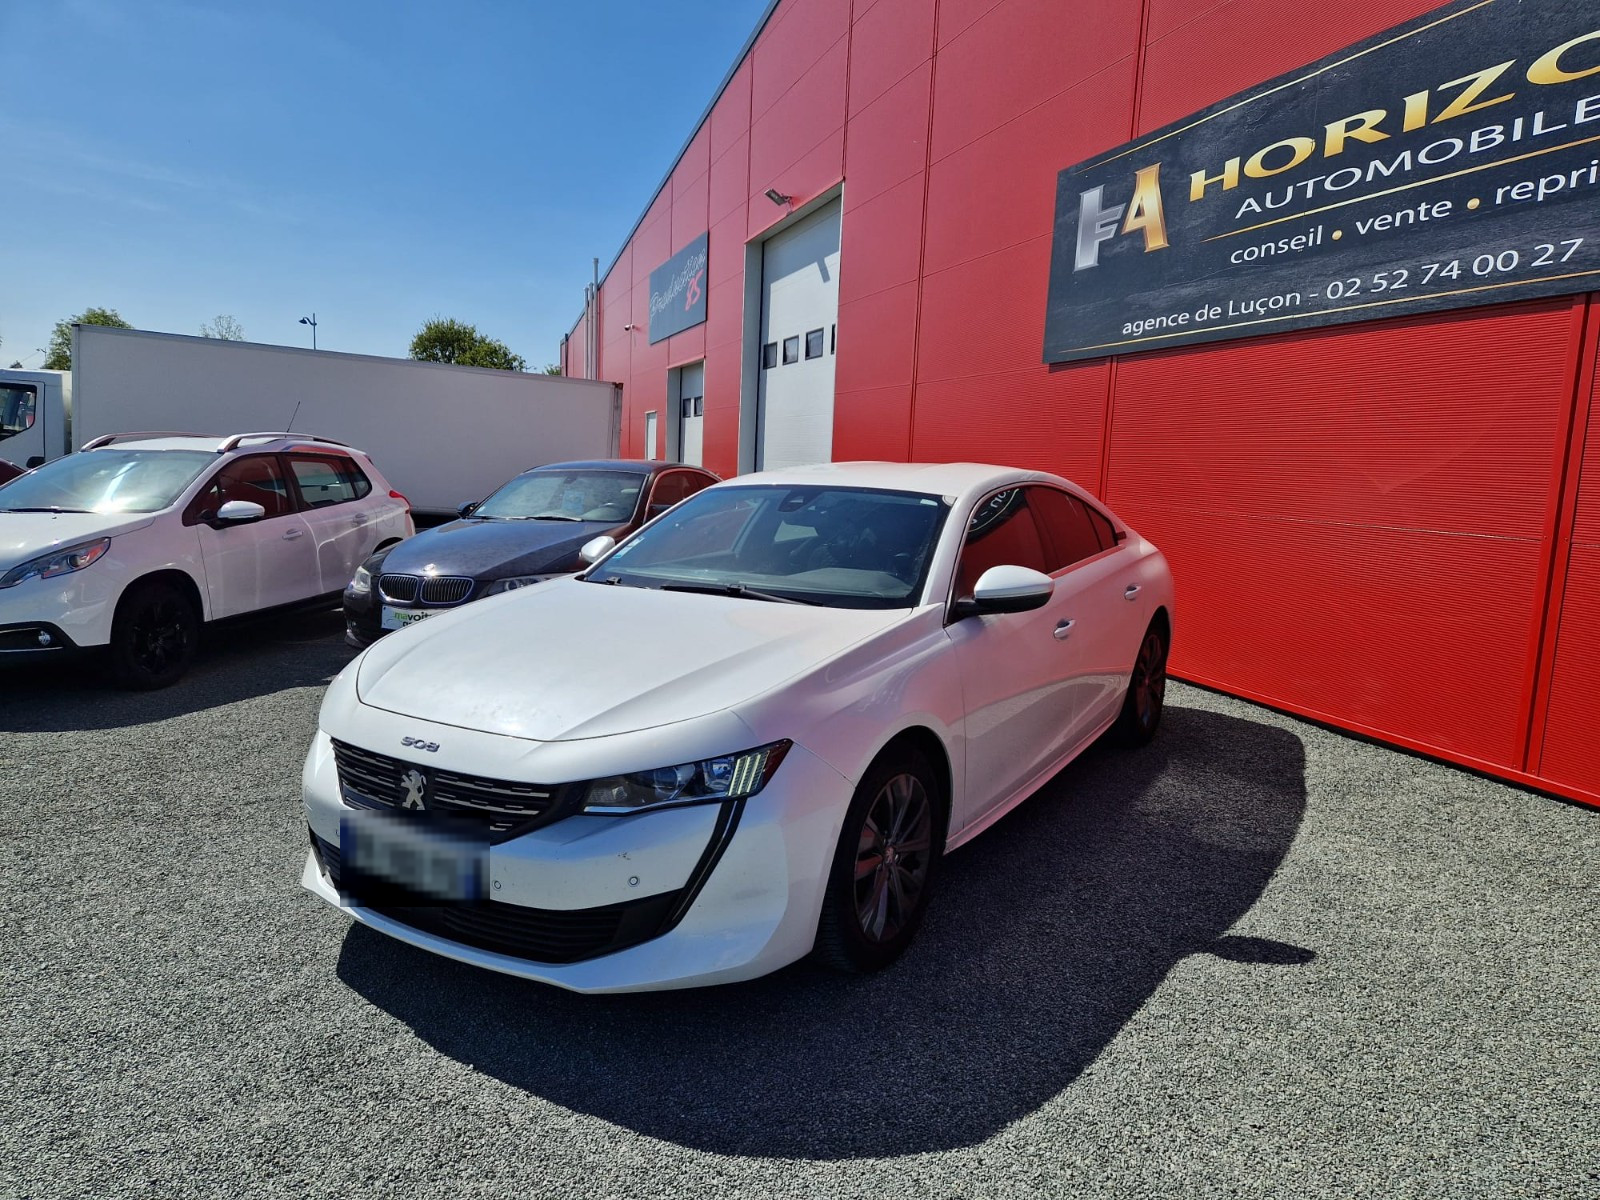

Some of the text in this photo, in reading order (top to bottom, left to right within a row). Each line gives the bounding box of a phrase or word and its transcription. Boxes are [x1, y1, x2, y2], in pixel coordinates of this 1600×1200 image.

[1235, 94, 1600, 218] AUTOMOBILE
[1229, 159, 1599, 264] conseil vente repri
[1122, 312, 1189, 335] agence
[1195, 304, 1222, 321] de
[1228, 291, 1301, 316] Luçon
[1326, 279, 1361, 299] 02
[1372, 272, 1408, 292] 52
[1421, 260, 1461, 285] 74
[1473, 249, 1519, 274] 00
[1531, 238, 1584, 265] 27
[401, 737, 440, 752] 508
